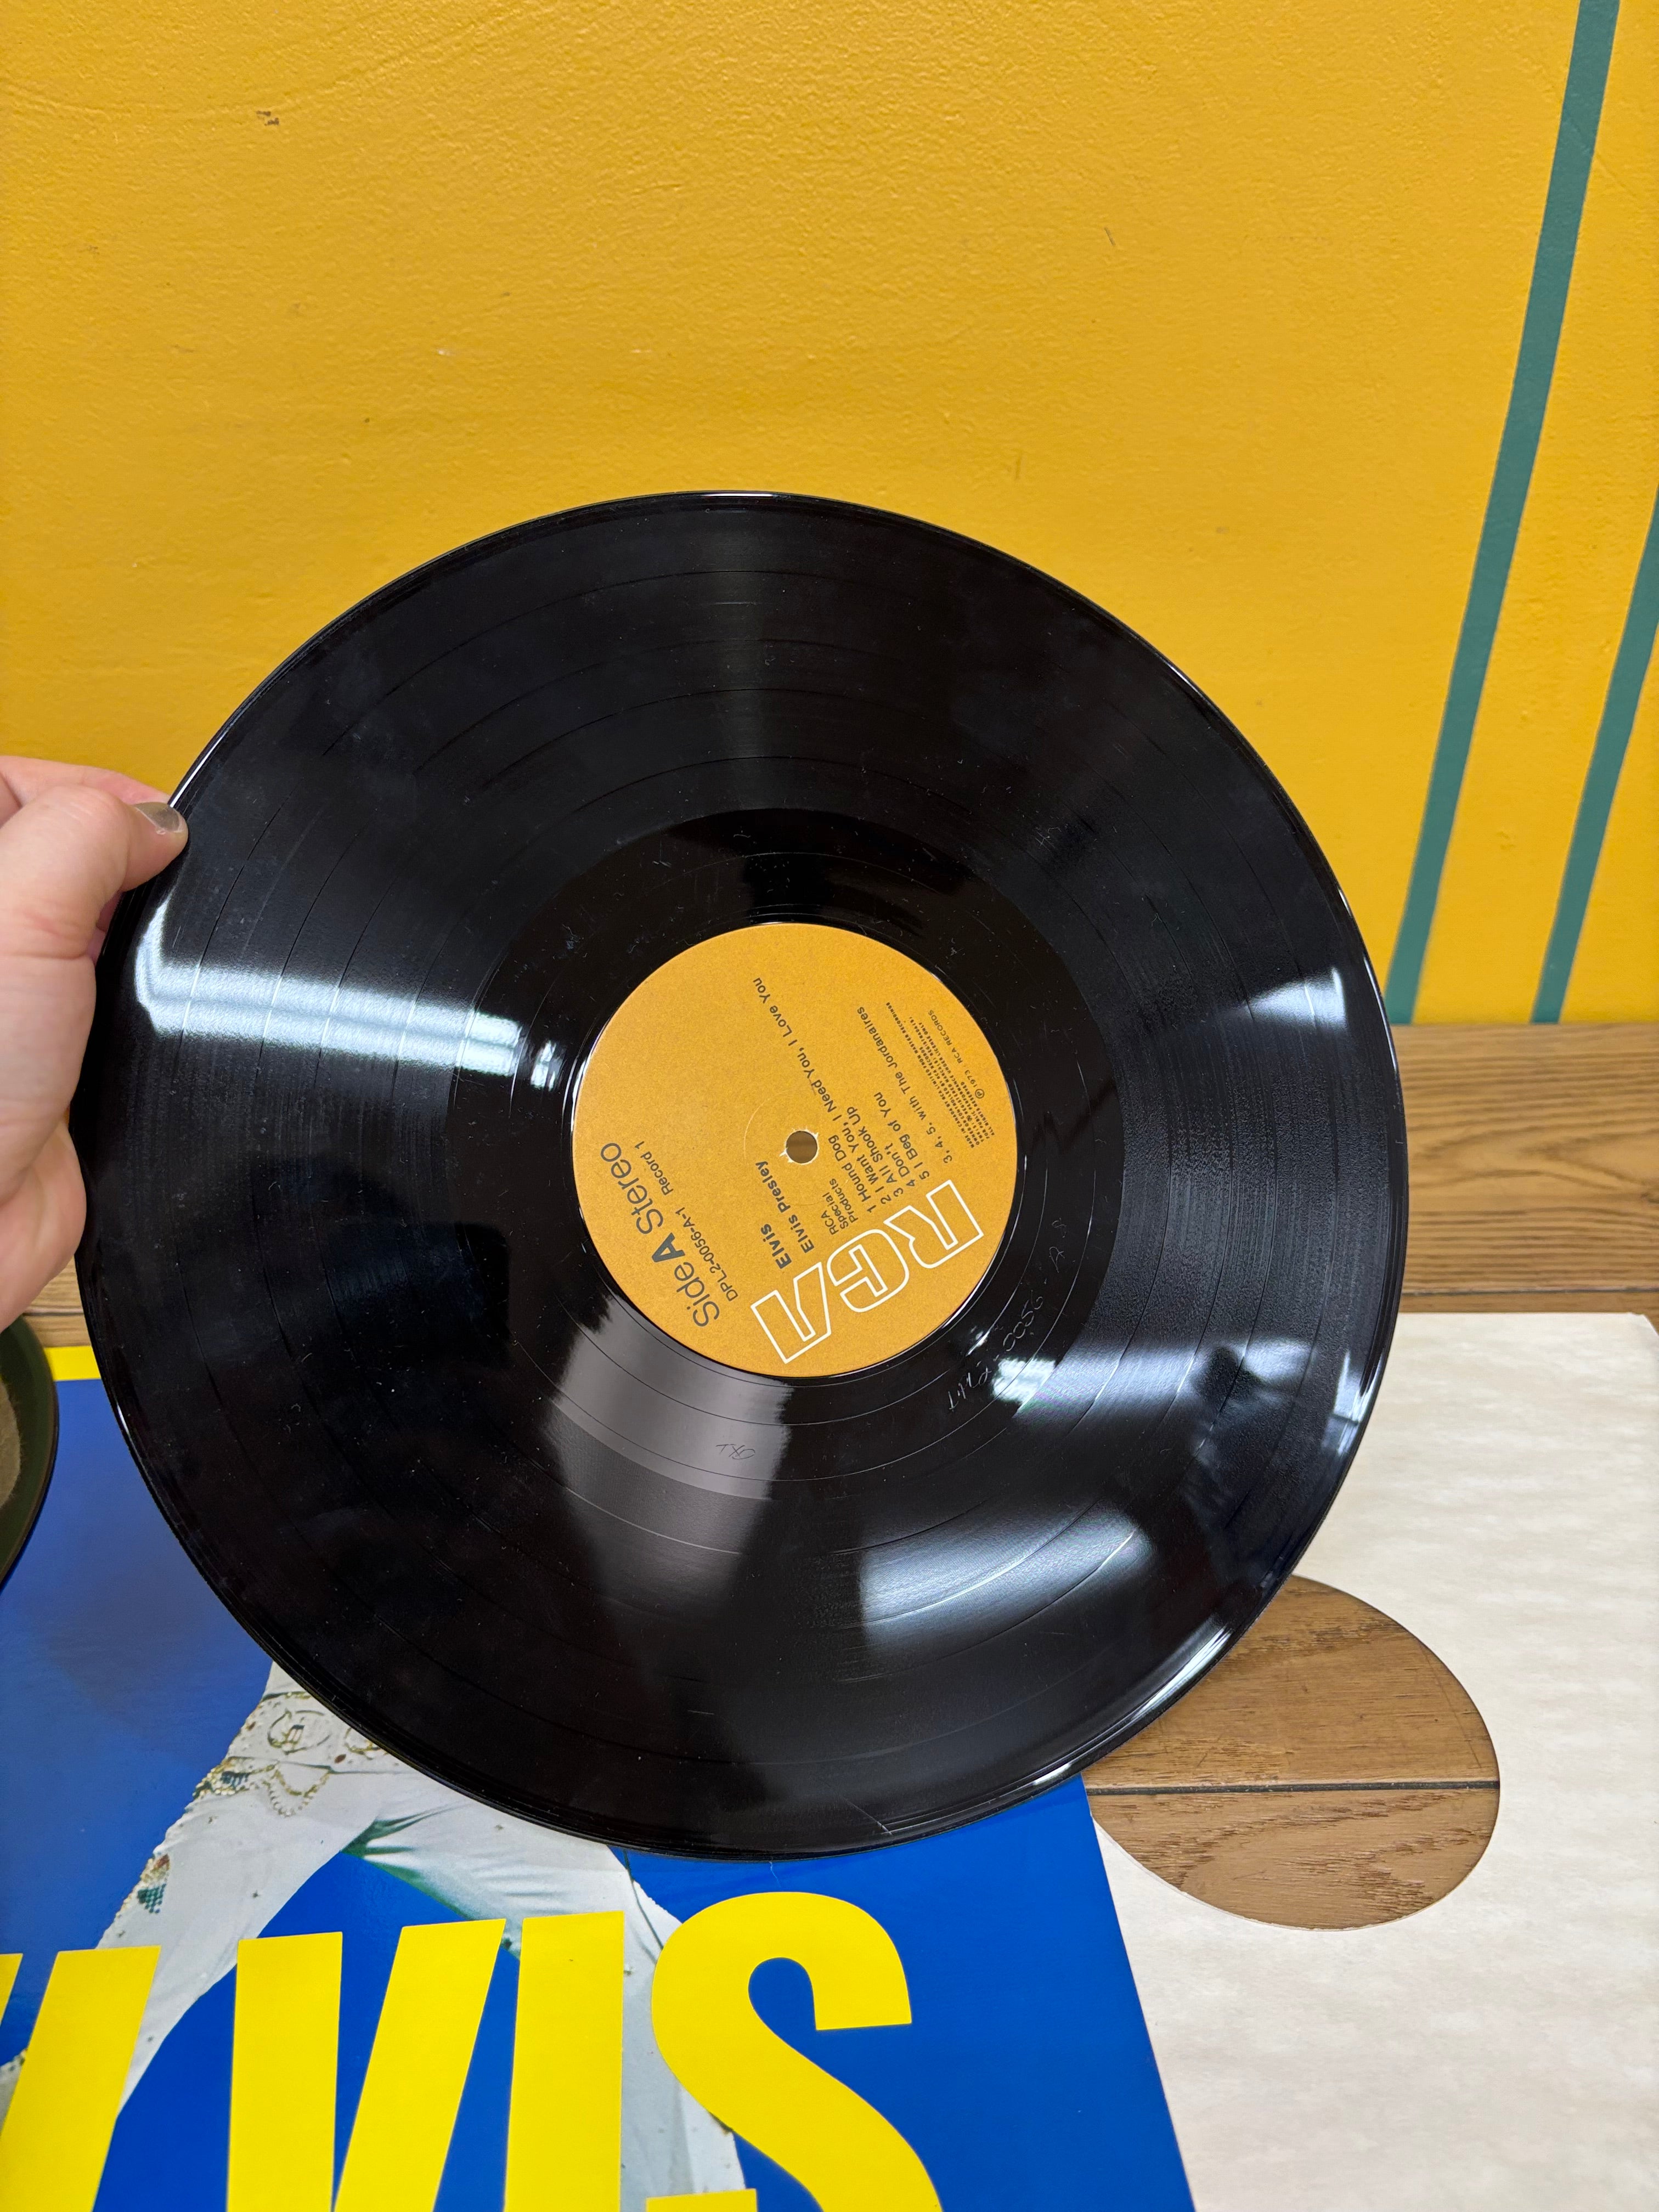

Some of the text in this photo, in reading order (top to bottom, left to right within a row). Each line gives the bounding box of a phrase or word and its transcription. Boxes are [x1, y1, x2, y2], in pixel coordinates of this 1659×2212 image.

[885, 1001, 907, 1034] RECORDINGS
[928, 1009, 953, 1046] RECORDS
[856, 1006, 898, 1069] Jordanaires
[904, 1034, 919, 1054] MASTER
[916, 1054, 928, 1069] FROM
[918, 1046, 935, 1070] RECORDS
[951, 1047, 963, 1064] RCA
[894, 1071, 911, 1095] The
[918, 1022, 990, 1139] FOR PUBLIC PERFORMANCE UNDER LICENSE ONLY
[925, 1068, 940, 1090] LIMITED
[932, 1069, 941, 1080] RCA
[964, 1069, 978, 1088] 1973
[752, 977, 892, 1205] 2 I Want You, I Need You, I Love You
[938, 1090, 946, 1101] RCA
[943, 1087, 965, 1120] CONTROLLED
[947, 1083, 969, 1115] REGISTERED
[960, 1081, 978, 1108] RESERVED
[873, 1091, 892, 1119] You
[909, 1095, 927, 1121] with
[948, 1107, 963, 1128] CANADA
[975, 1107, 990, 1127] RIGHTS
[887, 1119, 901, 1132] of
[962, 1119, 969, 1127] OR
[967, 1126, 980, 1146] OWNED
[846, 1106, 904, 1198] 3 All Shook Up
[898, 1133, 919, 1161] Beg
[934, 1135, 944, 1148] 4,
[964, 1134, 975, 1149] MADE
[884, 1142, 916, 1187] 4 Don't
[943, 1149, 953, 1164] 3,
[827, 1134, 877, 1214] 1 Hound Dog
[918, 1170, 930, 1181] 5
[754, 1160, 815, 1254] Elvis Presley
[821, 1191, 849, 1230] Special
[828, 1177, 859, 1224] Products
[634, 1140, 739, 1302] DPL2-0056-A-1 Record 1
[820, 1209, 840, 1235] RCA
[600, 1142, 720, 1328] Side A Stereo
[760, 1223, 793, 1270] Elvis
[751, 1180, 984, 1364] RCA
[0, 1892, 942, 2212] LVIS
